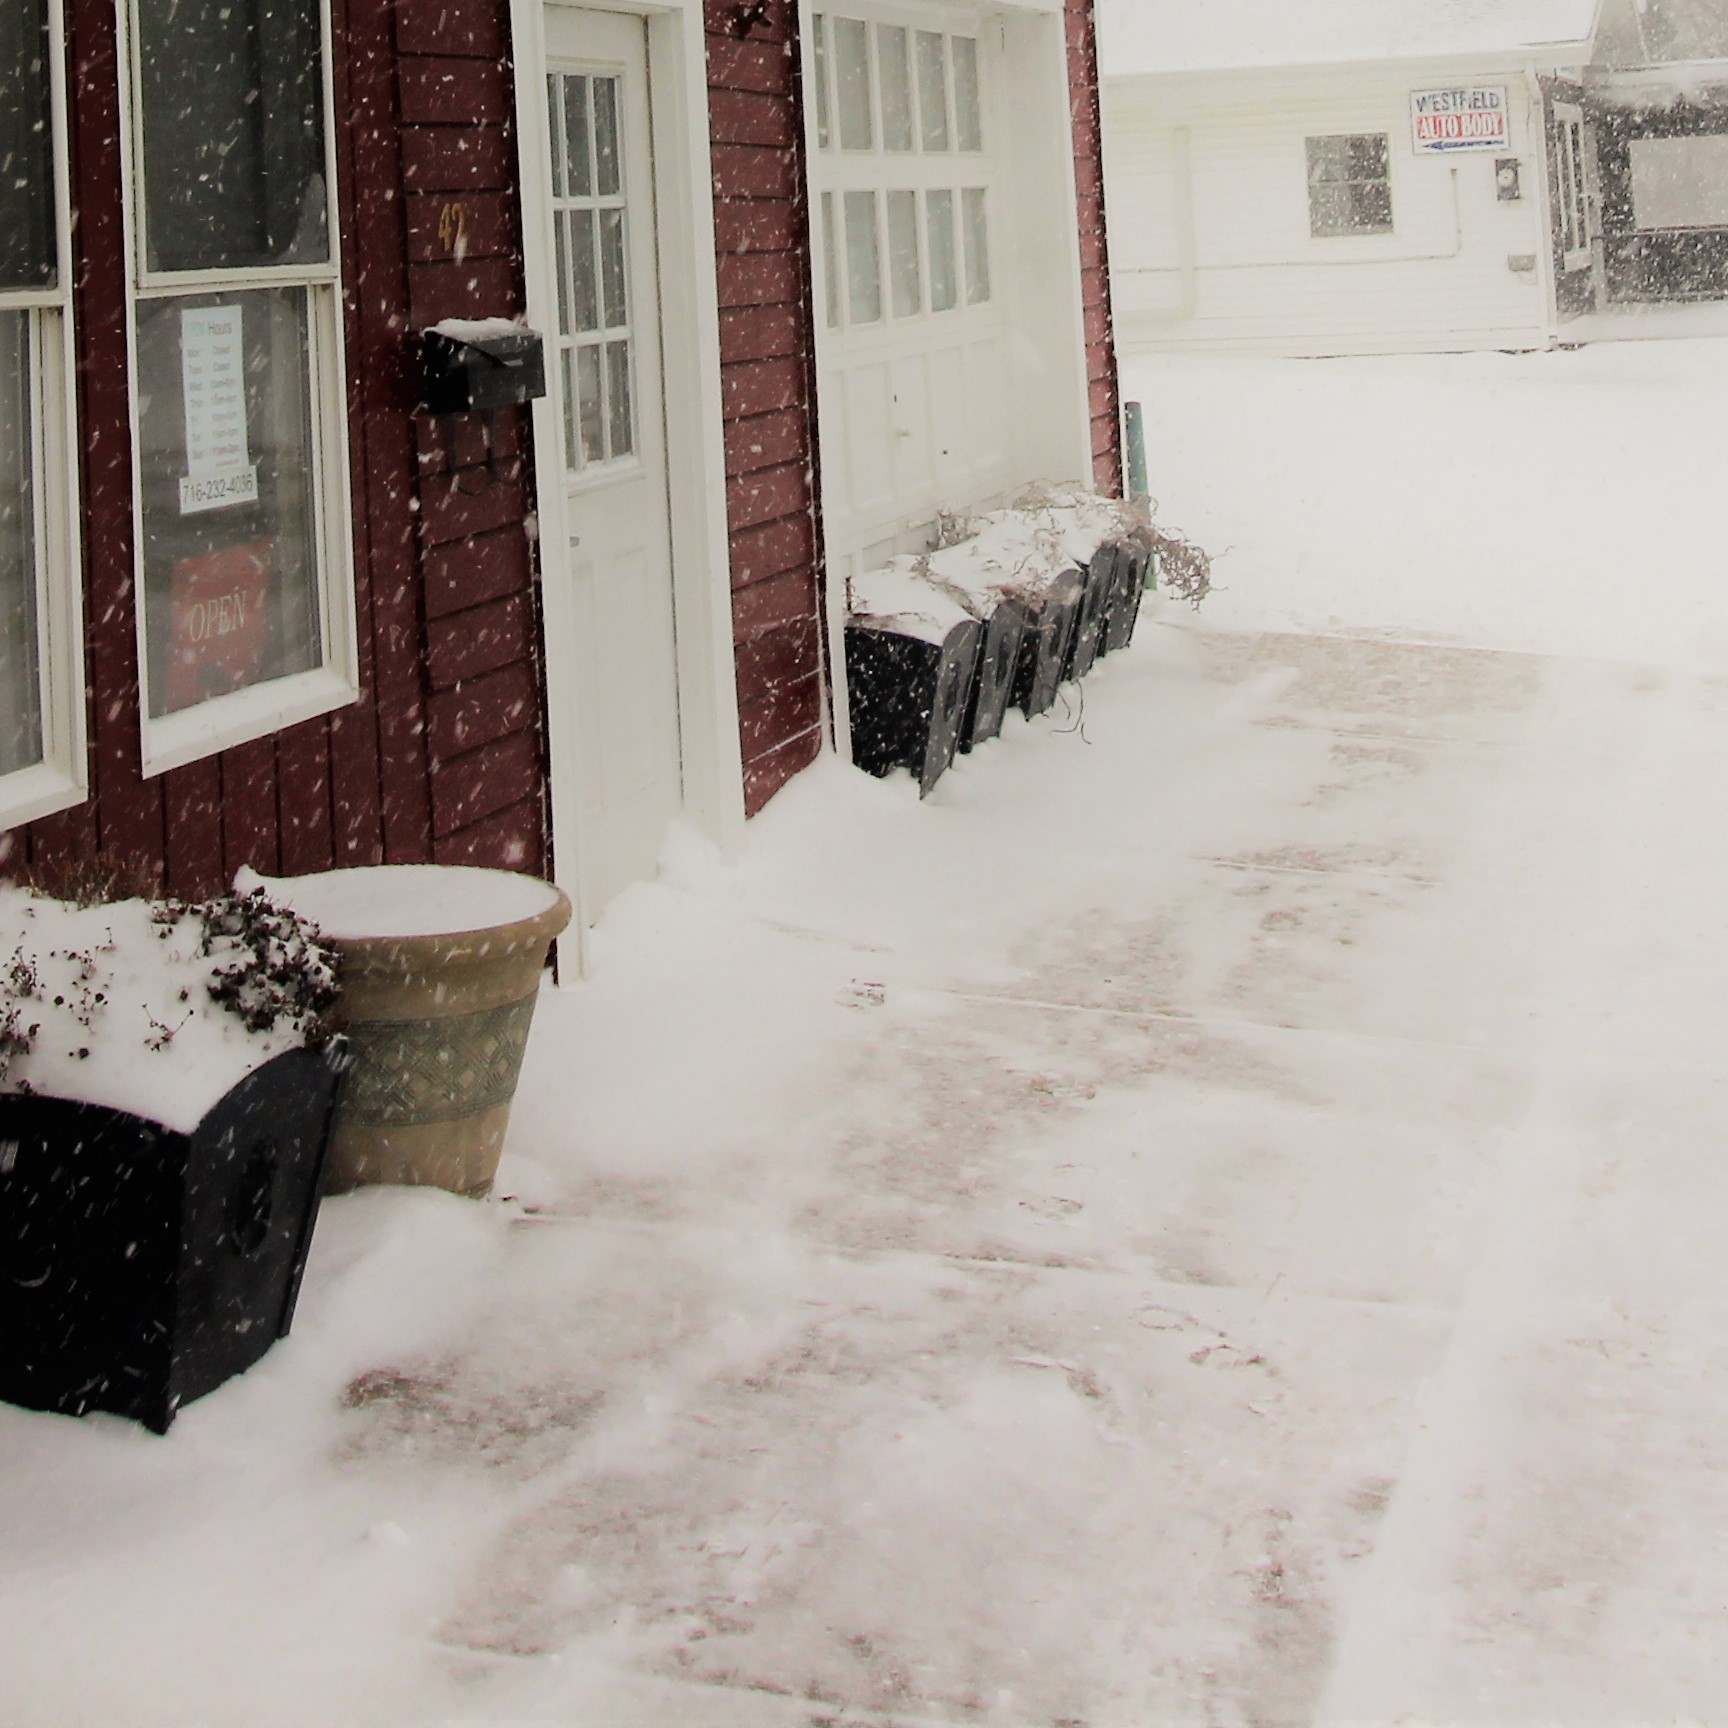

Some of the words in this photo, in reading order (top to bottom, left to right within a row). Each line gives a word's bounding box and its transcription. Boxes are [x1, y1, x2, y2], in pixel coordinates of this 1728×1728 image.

[1420, 114, 1459, 139] AUTO
[1462, 113, 1501, 136] BODY
[207, 321, 232, 335] Hours
[190, 591, 247, 642] OPEN
